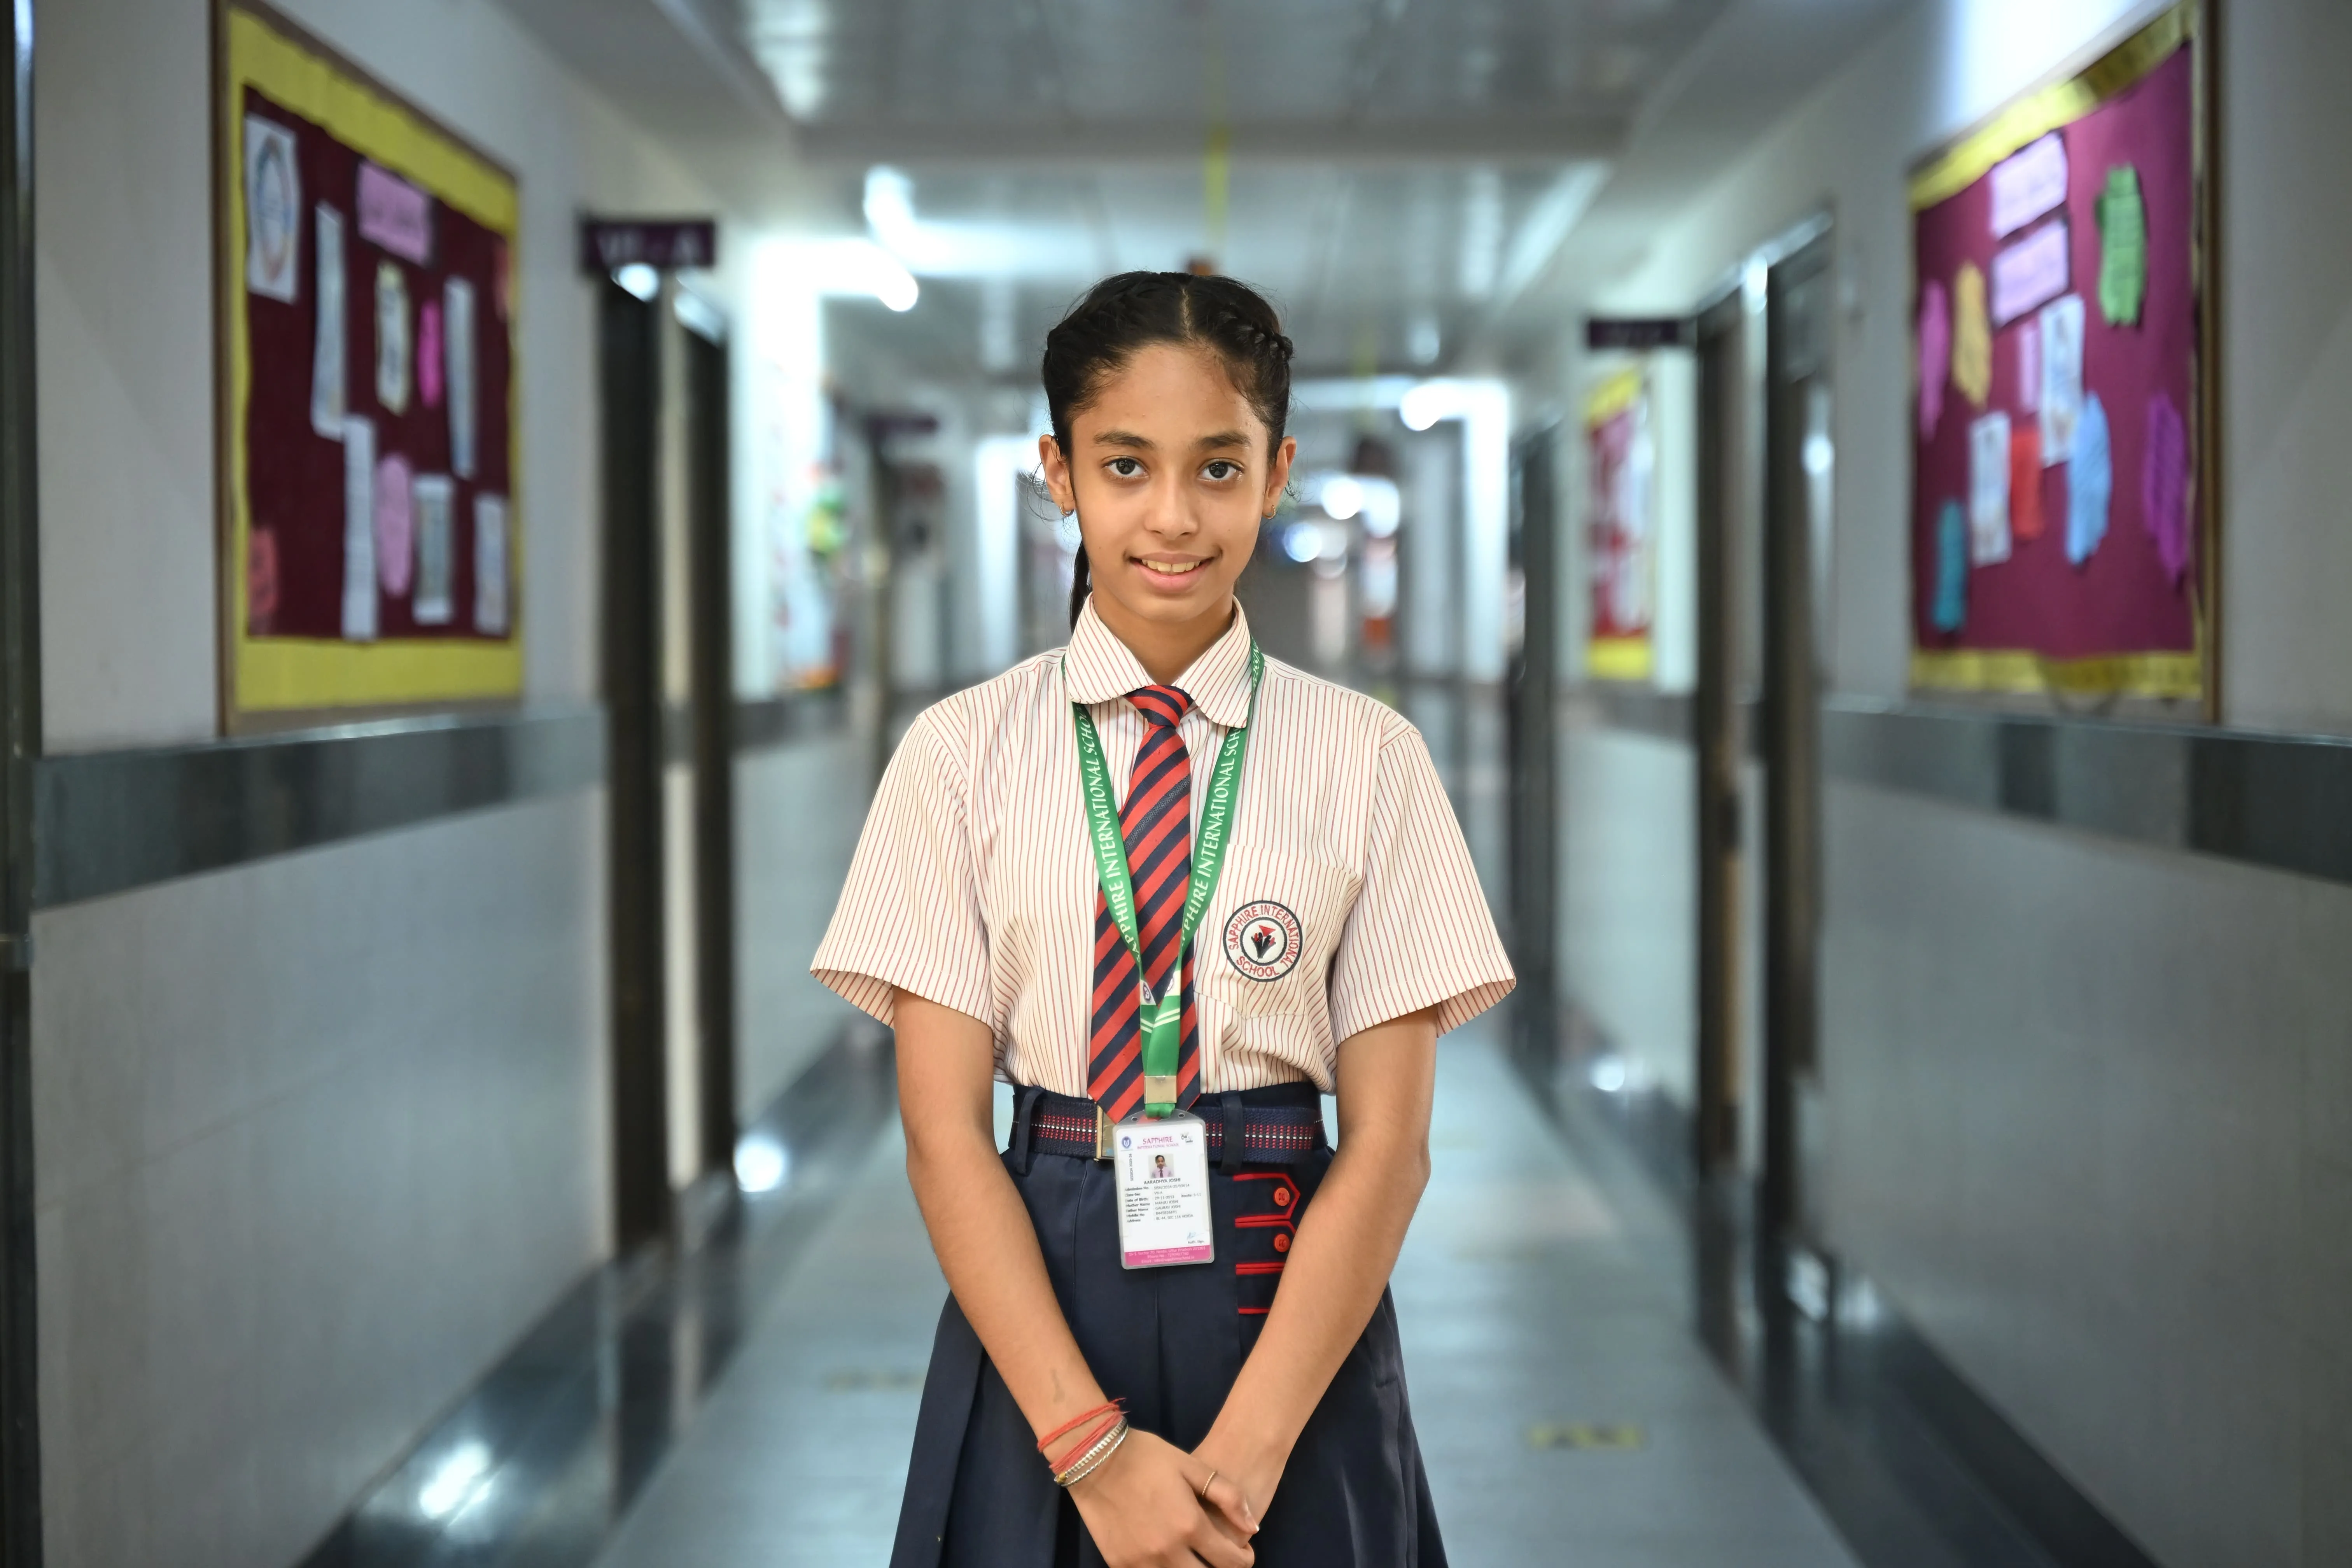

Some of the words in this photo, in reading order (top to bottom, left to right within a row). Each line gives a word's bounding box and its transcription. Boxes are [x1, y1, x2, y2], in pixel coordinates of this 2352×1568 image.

[1086, 758, 1121, 878] INTERNATIONAL
[1197, 758, 1235, 878] INTERNATIONAL
[1228, 906, 1259, 950] SAPPHIRE
[1260, 905, 1299, 968] INTERNATIONAL
[1237, 956, 1280, 977] SCHOOL
[1143, 1136, 1173, 1145] SAPPHIRE
